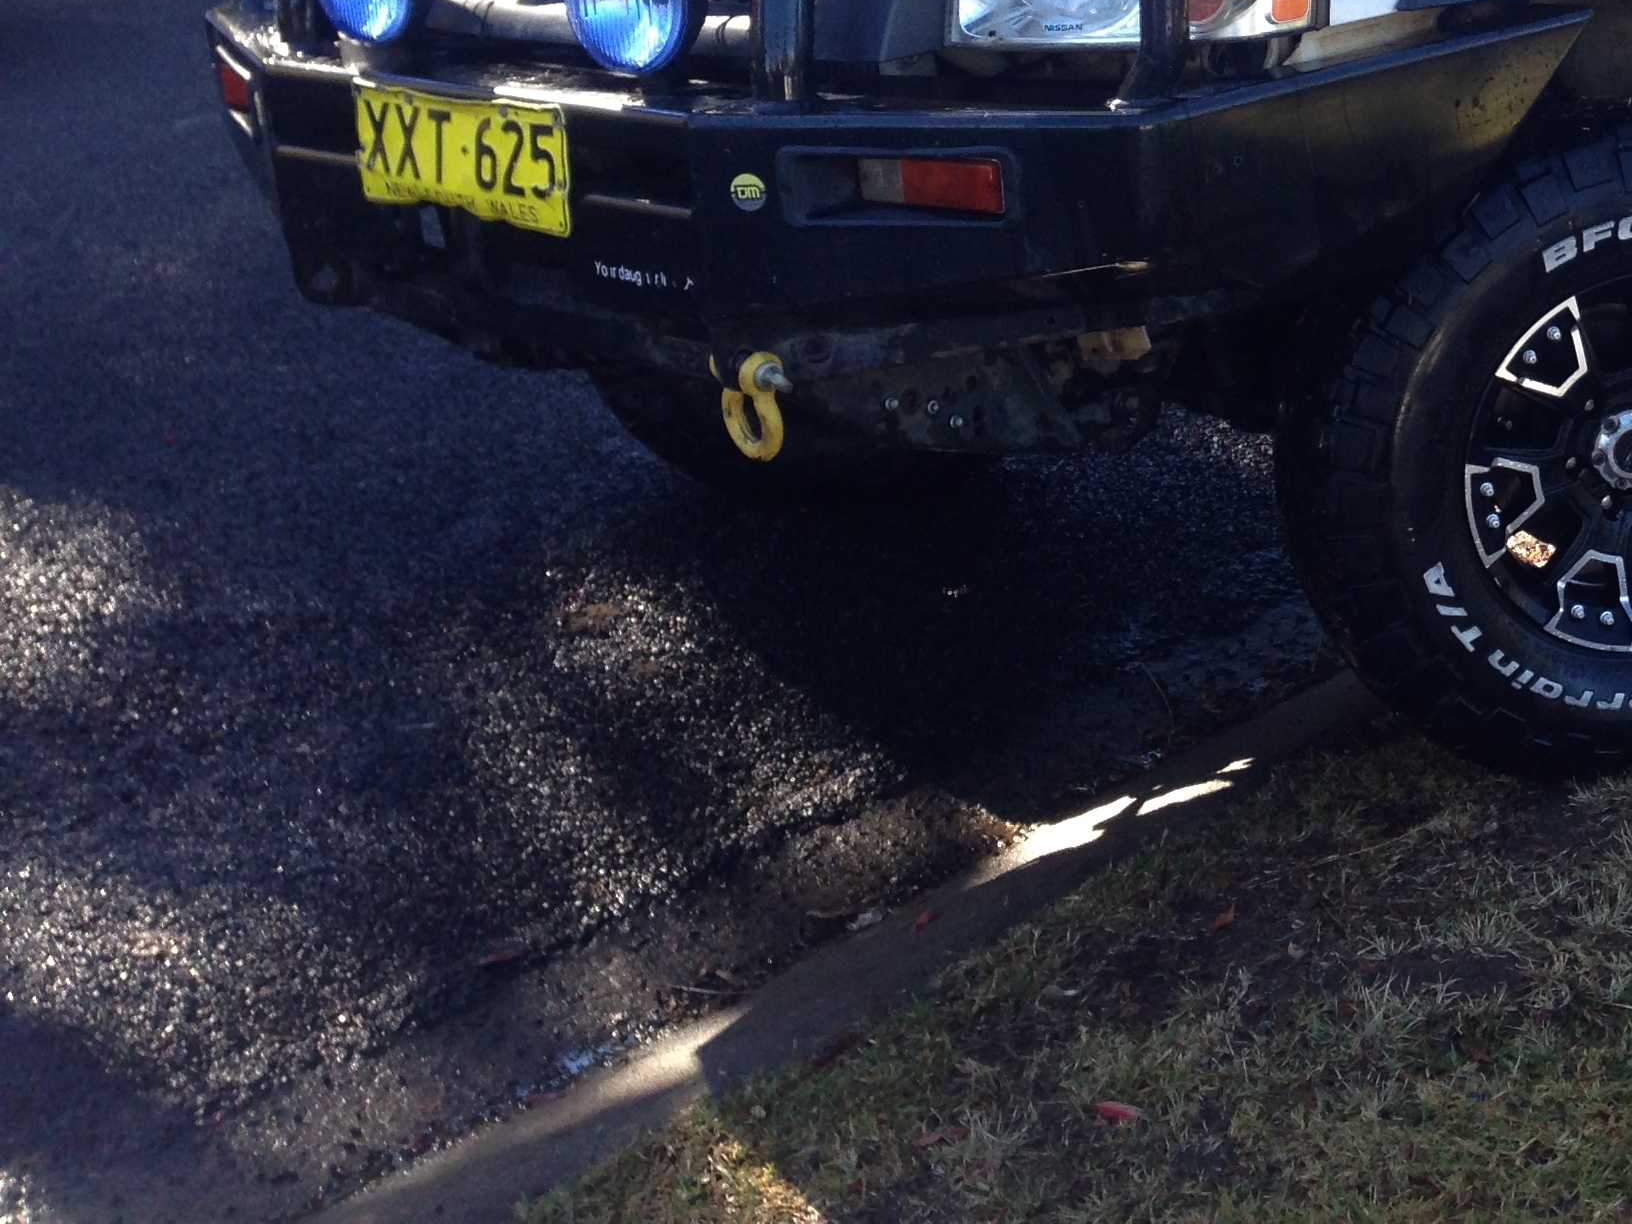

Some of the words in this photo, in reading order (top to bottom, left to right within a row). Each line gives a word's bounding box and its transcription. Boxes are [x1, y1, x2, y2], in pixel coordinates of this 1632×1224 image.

[1044, 23, 1083, 32] NISSAN
[485, 198, 540, 224] WALES
[1423, 561, 1483, 653] T/A
